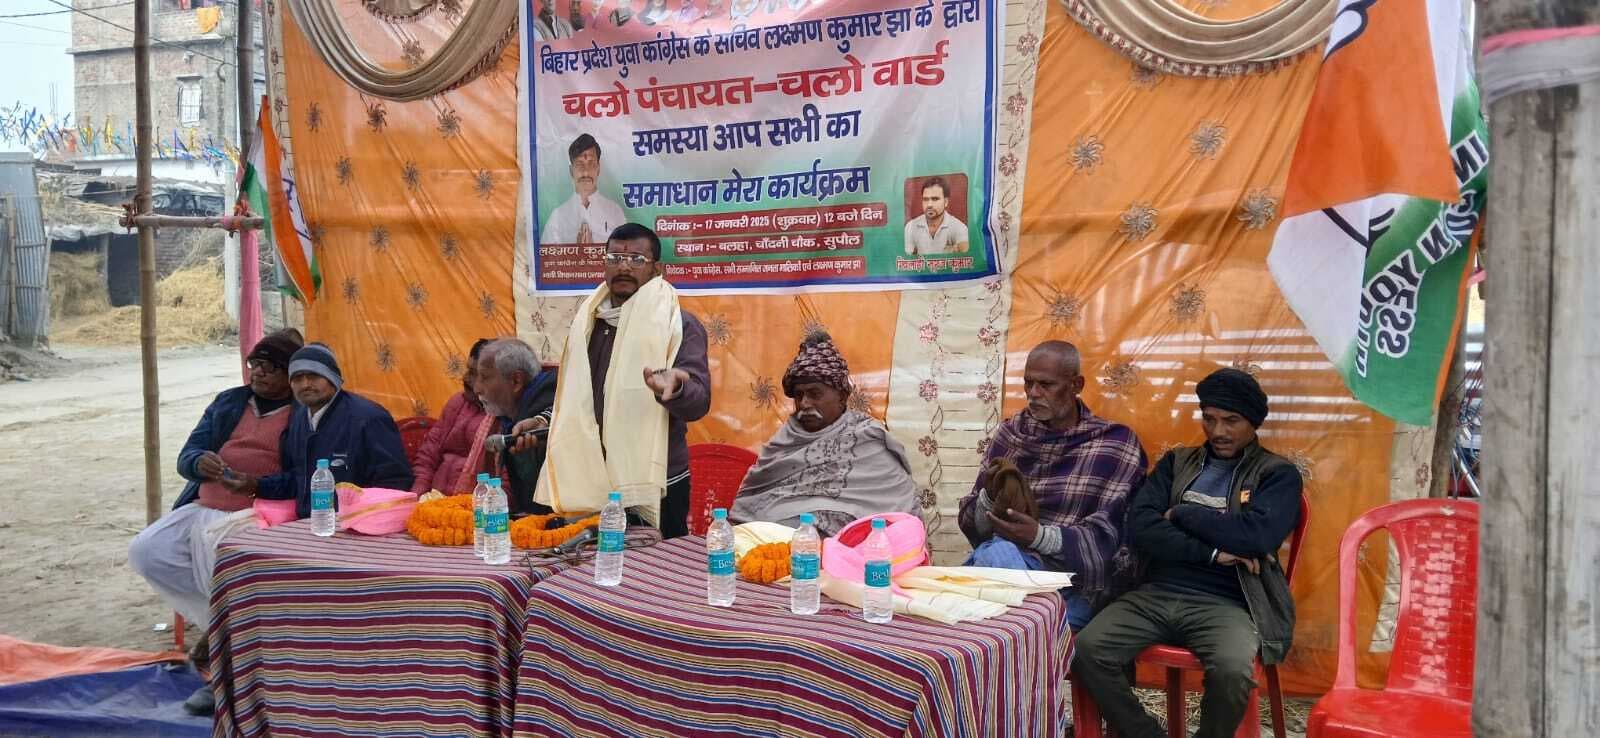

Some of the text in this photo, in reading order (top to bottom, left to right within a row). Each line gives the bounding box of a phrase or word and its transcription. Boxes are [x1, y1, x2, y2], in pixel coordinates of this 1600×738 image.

[541, 0, 980, 78] बिहार प्रदेश युवा कांग्रेस के सचिव लक्ष्मण कुमार झा के द्वारा
[562, 81, 630, 118] चलो
[872, 40, 950, 86] वार्ड
[632, 103, 861, 157] समस्या आप सभी का
[622, 158, 871, 209] समाधान मेरा कार्यक्रम
[656, 219, 691, 232] दिनांक
[705, 219, 713, 230] 17
[714, 215, 749, 229] जनवरी
[750, 215, 769, 227] 2025
[772, 211, 821, 231] (शुक्रवार)
[824, 212, 835, 223] 12
[836, 208, 858, 221] बजे
[860, 207, 883, 221] दिन
[676, 242, 704, 253] स्थान
[823, 231, 861, 250] सुपौल
